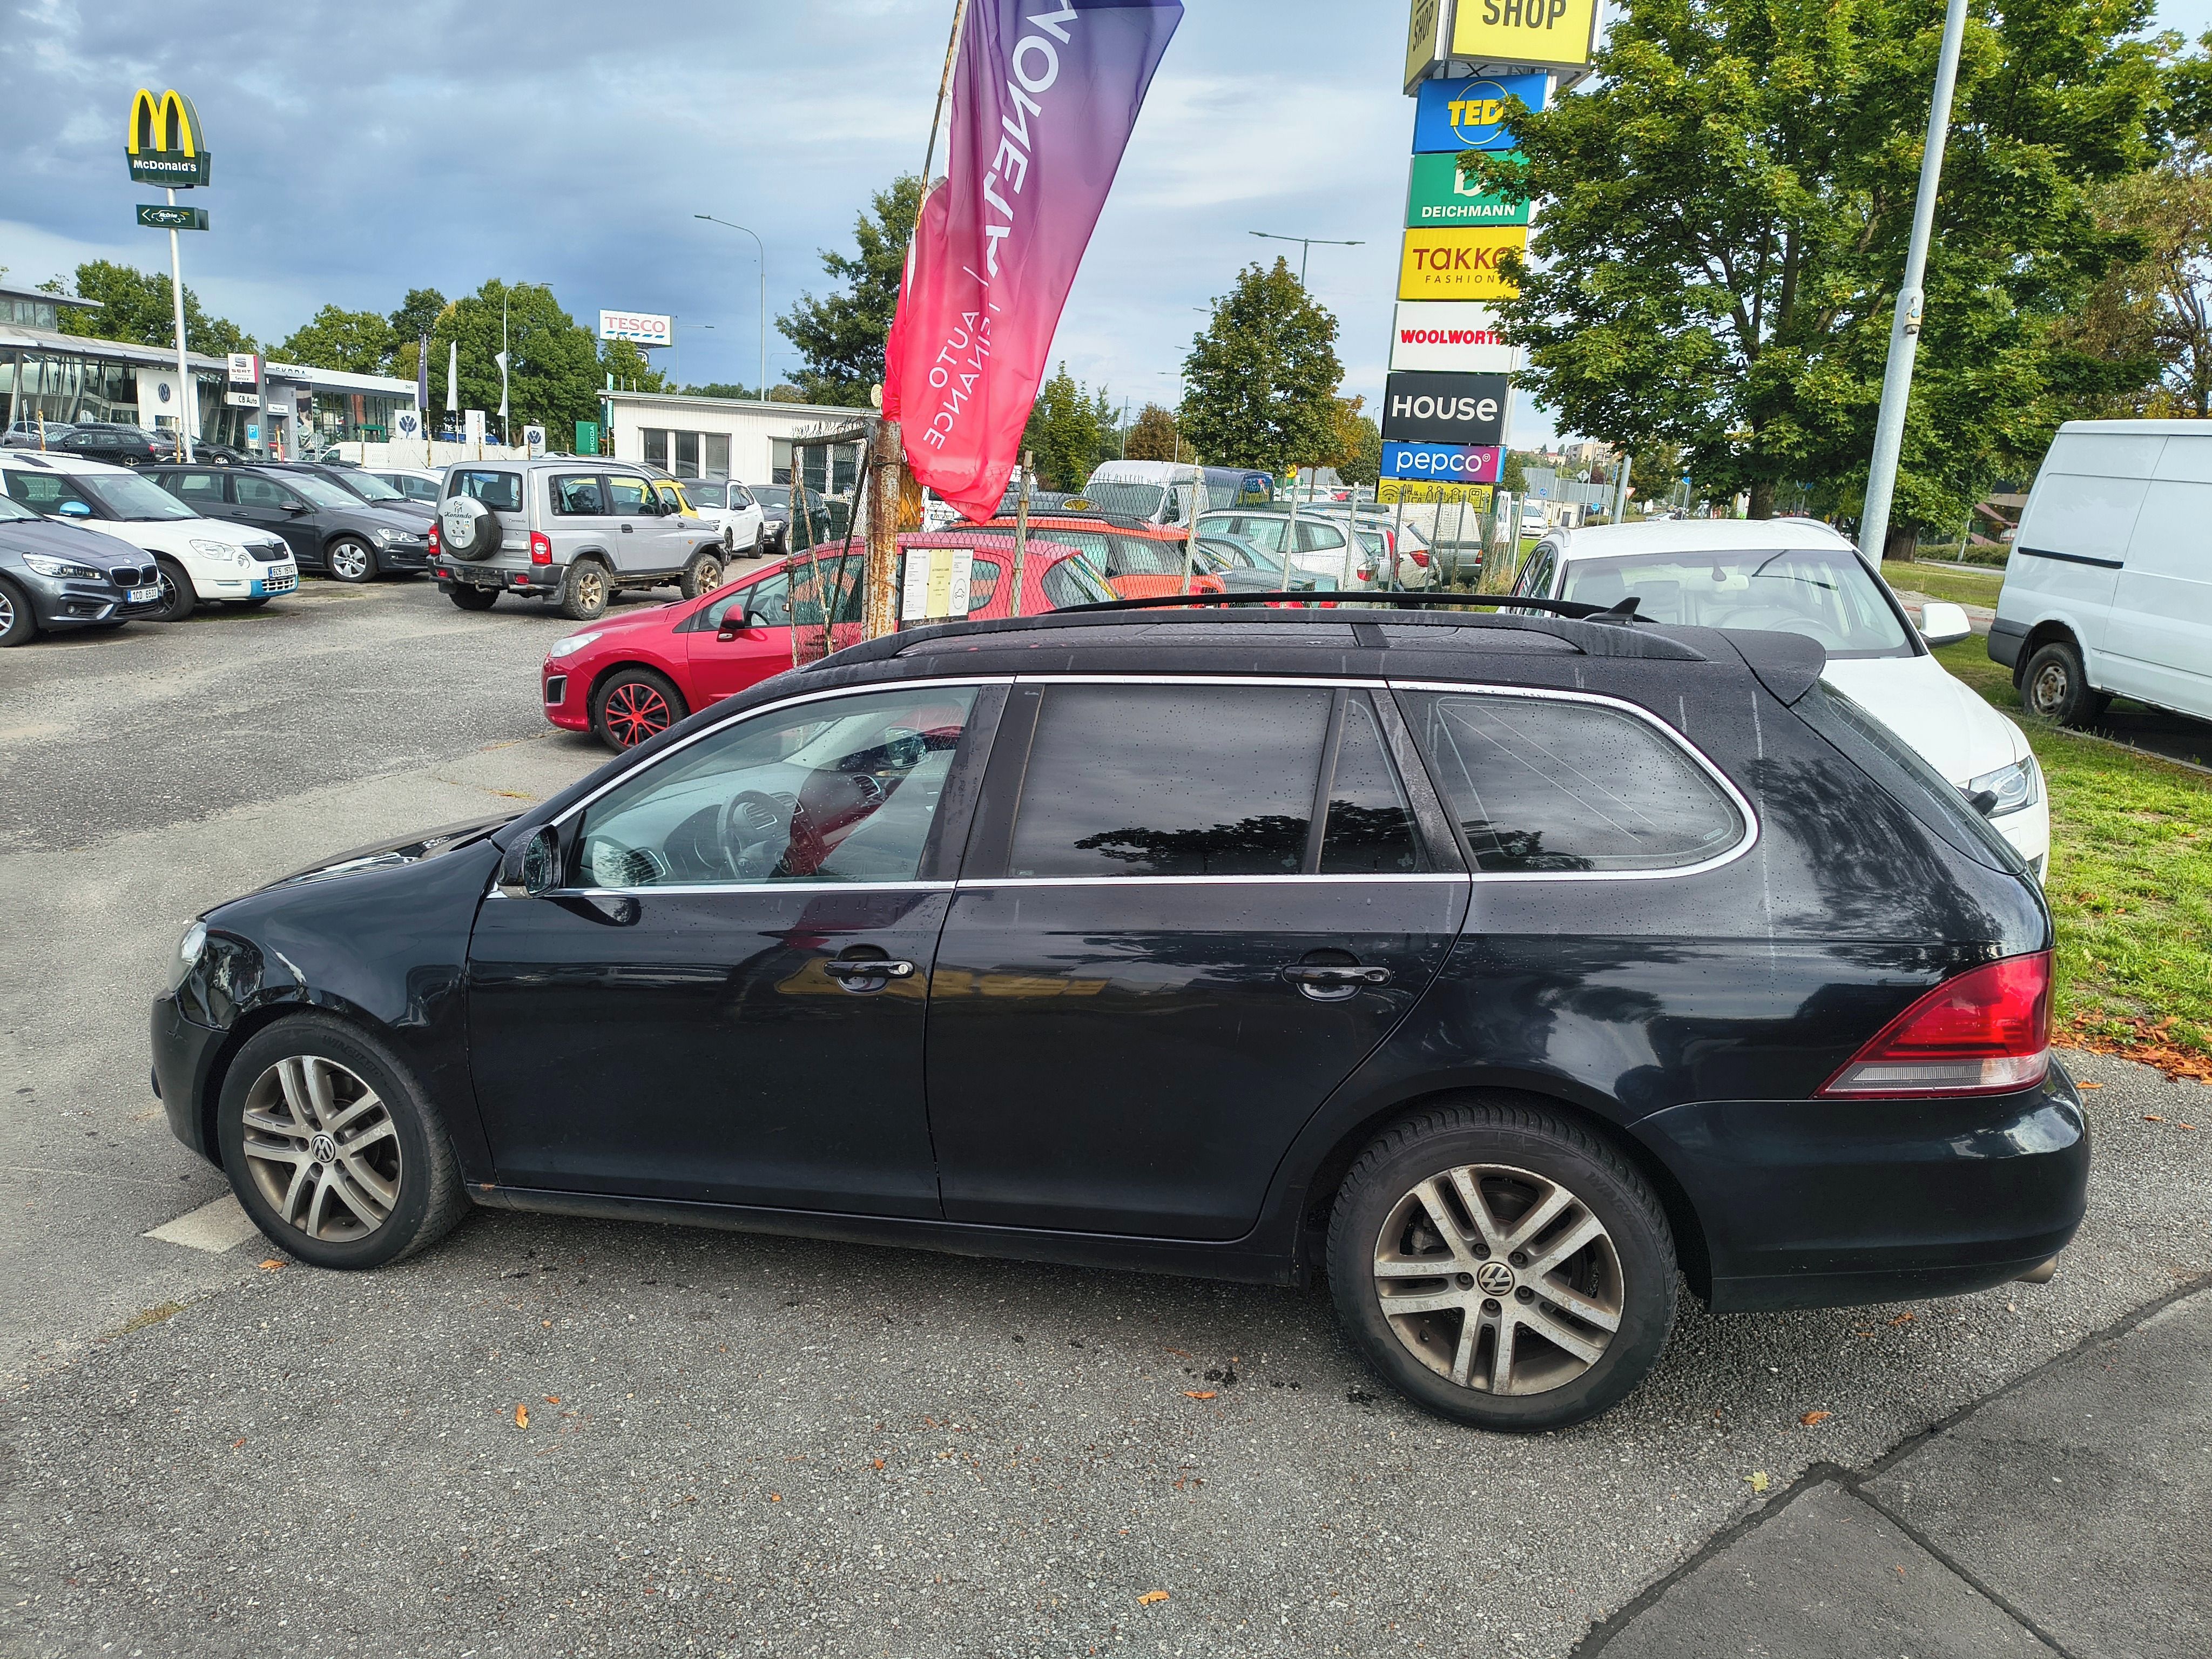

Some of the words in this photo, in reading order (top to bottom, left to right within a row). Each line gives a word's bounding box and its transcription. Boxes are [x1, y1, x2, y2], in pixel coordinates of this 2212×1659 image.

[1482, 0, 1566, 29] SHOP
[1413, 1, 1434, 52] SHOP
[133, 159, 197, 172] McDonald's
[1421, 204, 1515, 218] DEICHMANN
[1425, 274, 1495, 284] FASHION
[604, 316, 665, 333] TESCO
[238, 395, 245, 403] CB
[246, 395, 257, 404] Auto
[1396, 450, 1482, 474] pepco
[133, 591, 142, 600] 1CD
